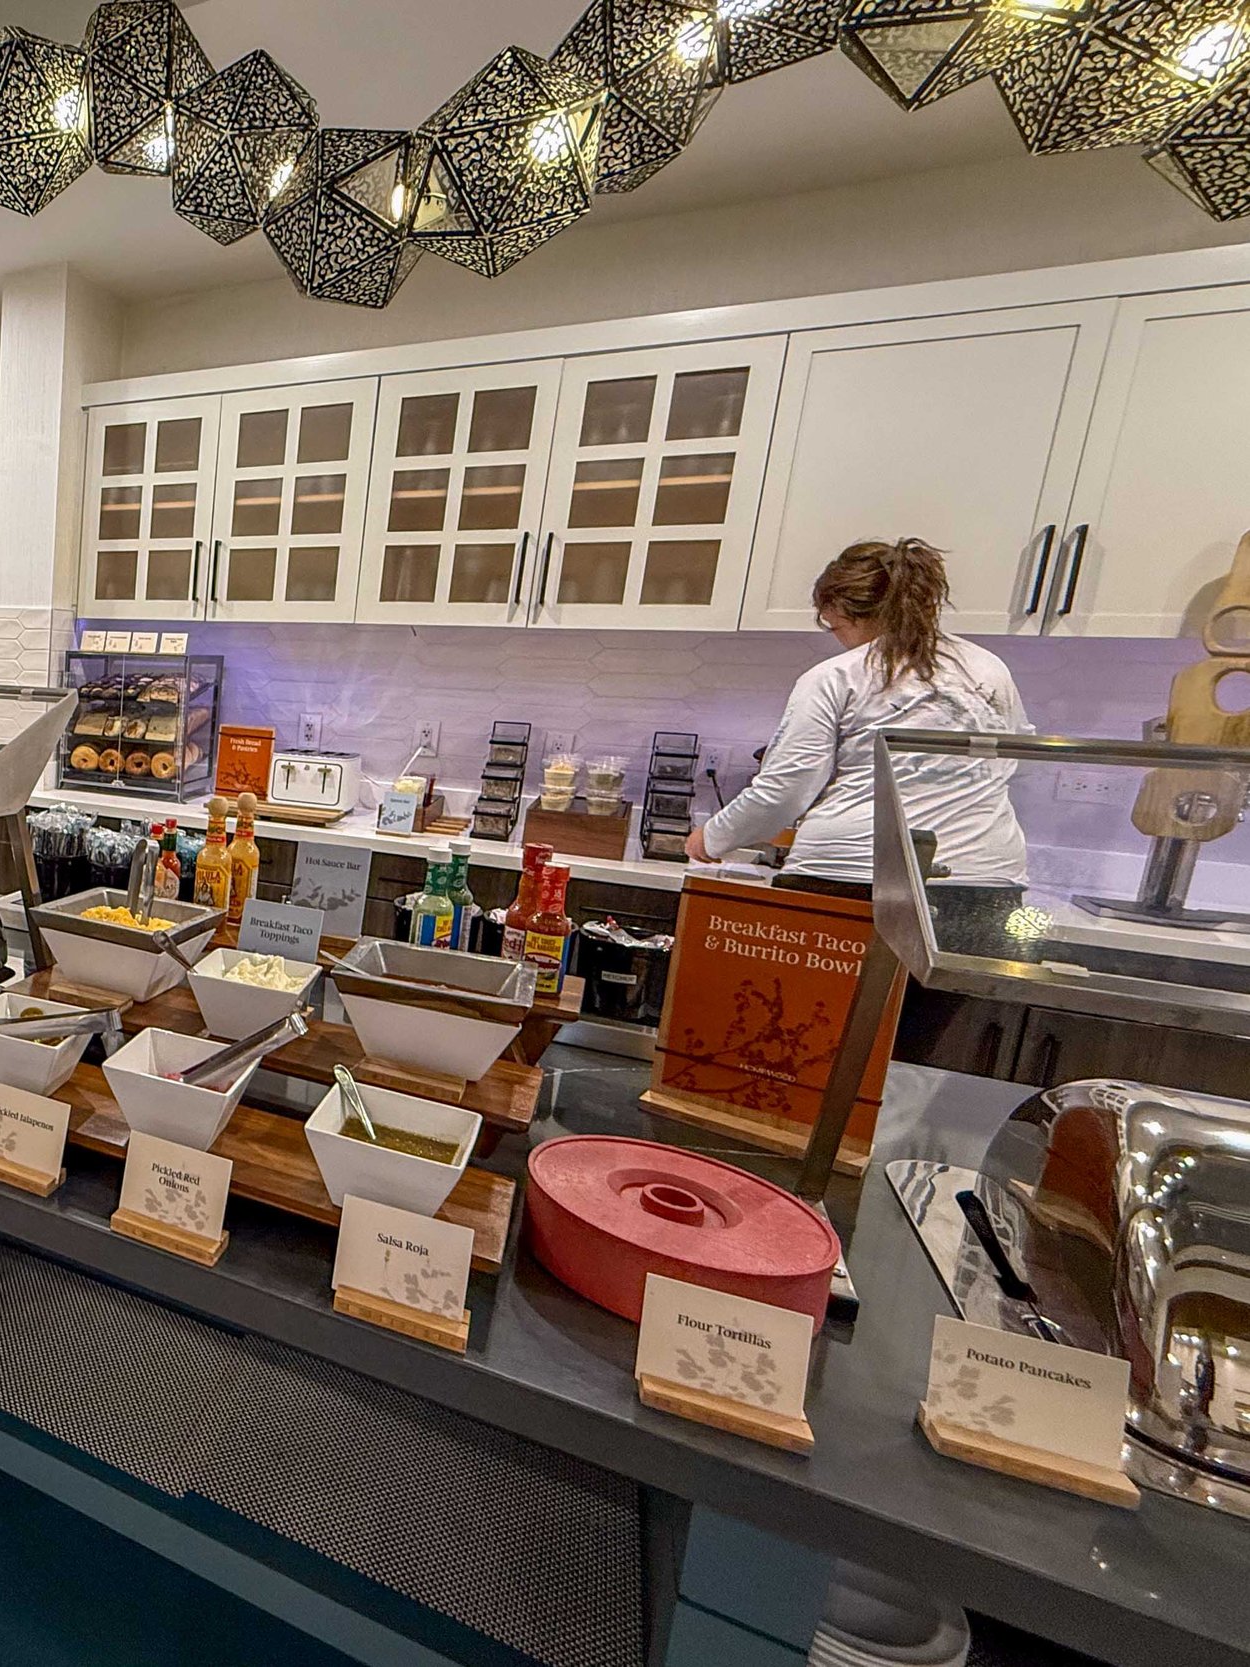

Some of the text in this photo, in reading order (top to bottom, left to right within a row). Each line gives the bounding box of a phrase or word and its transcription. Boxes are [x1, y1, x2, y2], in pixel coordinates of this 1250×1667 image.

[305, 856, 362, 871] Hot Sauce Bar
[250, 916, 314, 936] Breakfast Taco
[259, 930, 300, 944] Toppings
[709, 915, 867, 956] Breakfast Taco
[704, 934, 863, 977] & Burrito Bowl
[151, 1162, 200, 1186] Pickled Red
[158, 1176, 190, 1194] Onions
[376, 1232, 430, 1257] Salsa Roja
[677, 1313, 772, 1350] Flour Tortillas
[966, 1347, 1092, 1389] Potato Pancakes
